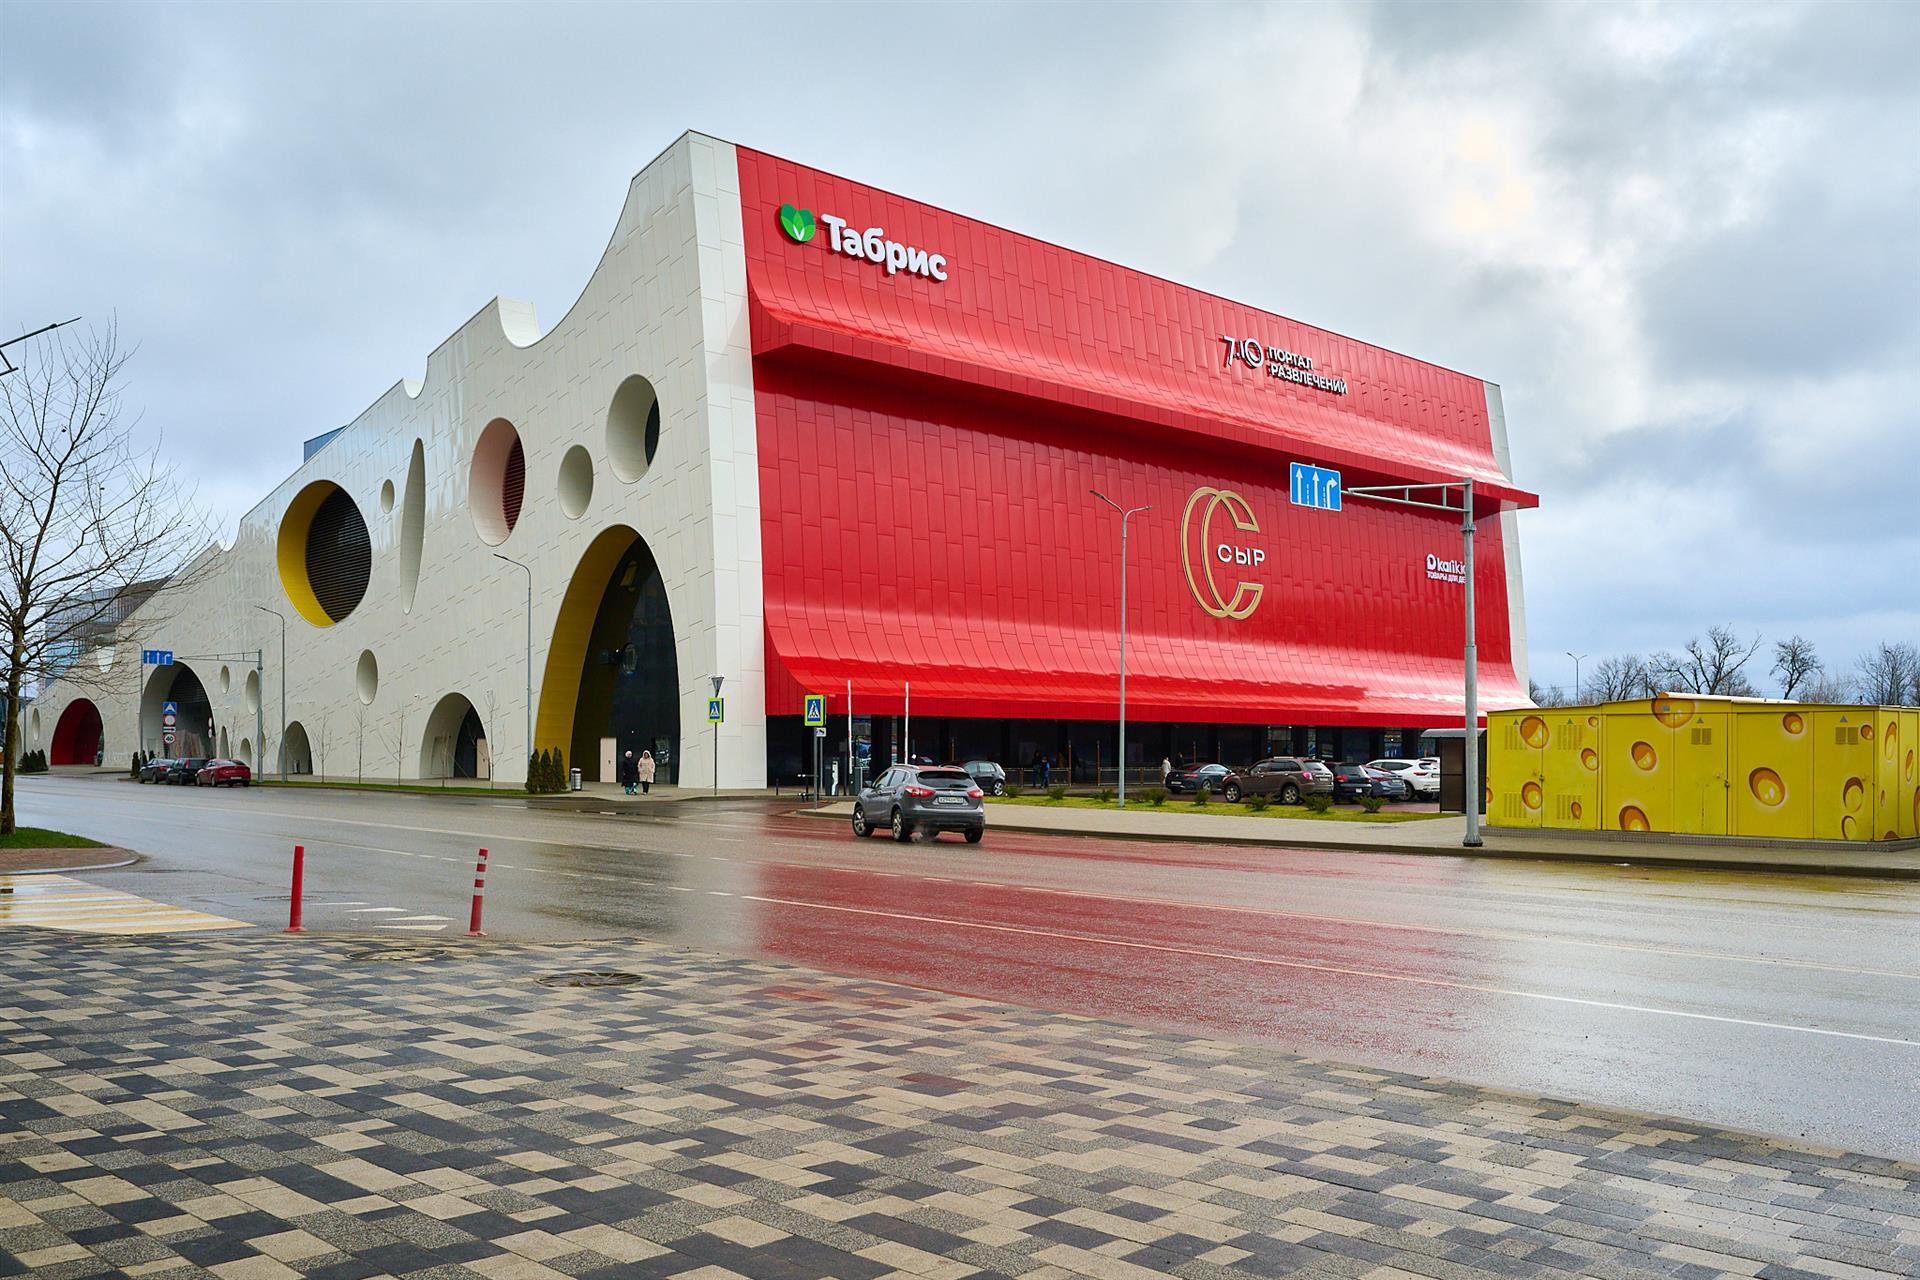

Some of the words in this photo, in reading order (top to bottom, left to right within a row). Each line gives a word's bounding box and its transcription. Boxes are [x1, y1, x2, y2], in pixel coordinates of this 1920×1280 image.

[821, 213, 948, 281] Табрис
[1268, 346, 1313, 370] ПОРТАЛ
[1270, 364, 1348, 394] РАЗВЛЕЧЕНИЙ
[1217, 544, 1265, 566] СЫР
